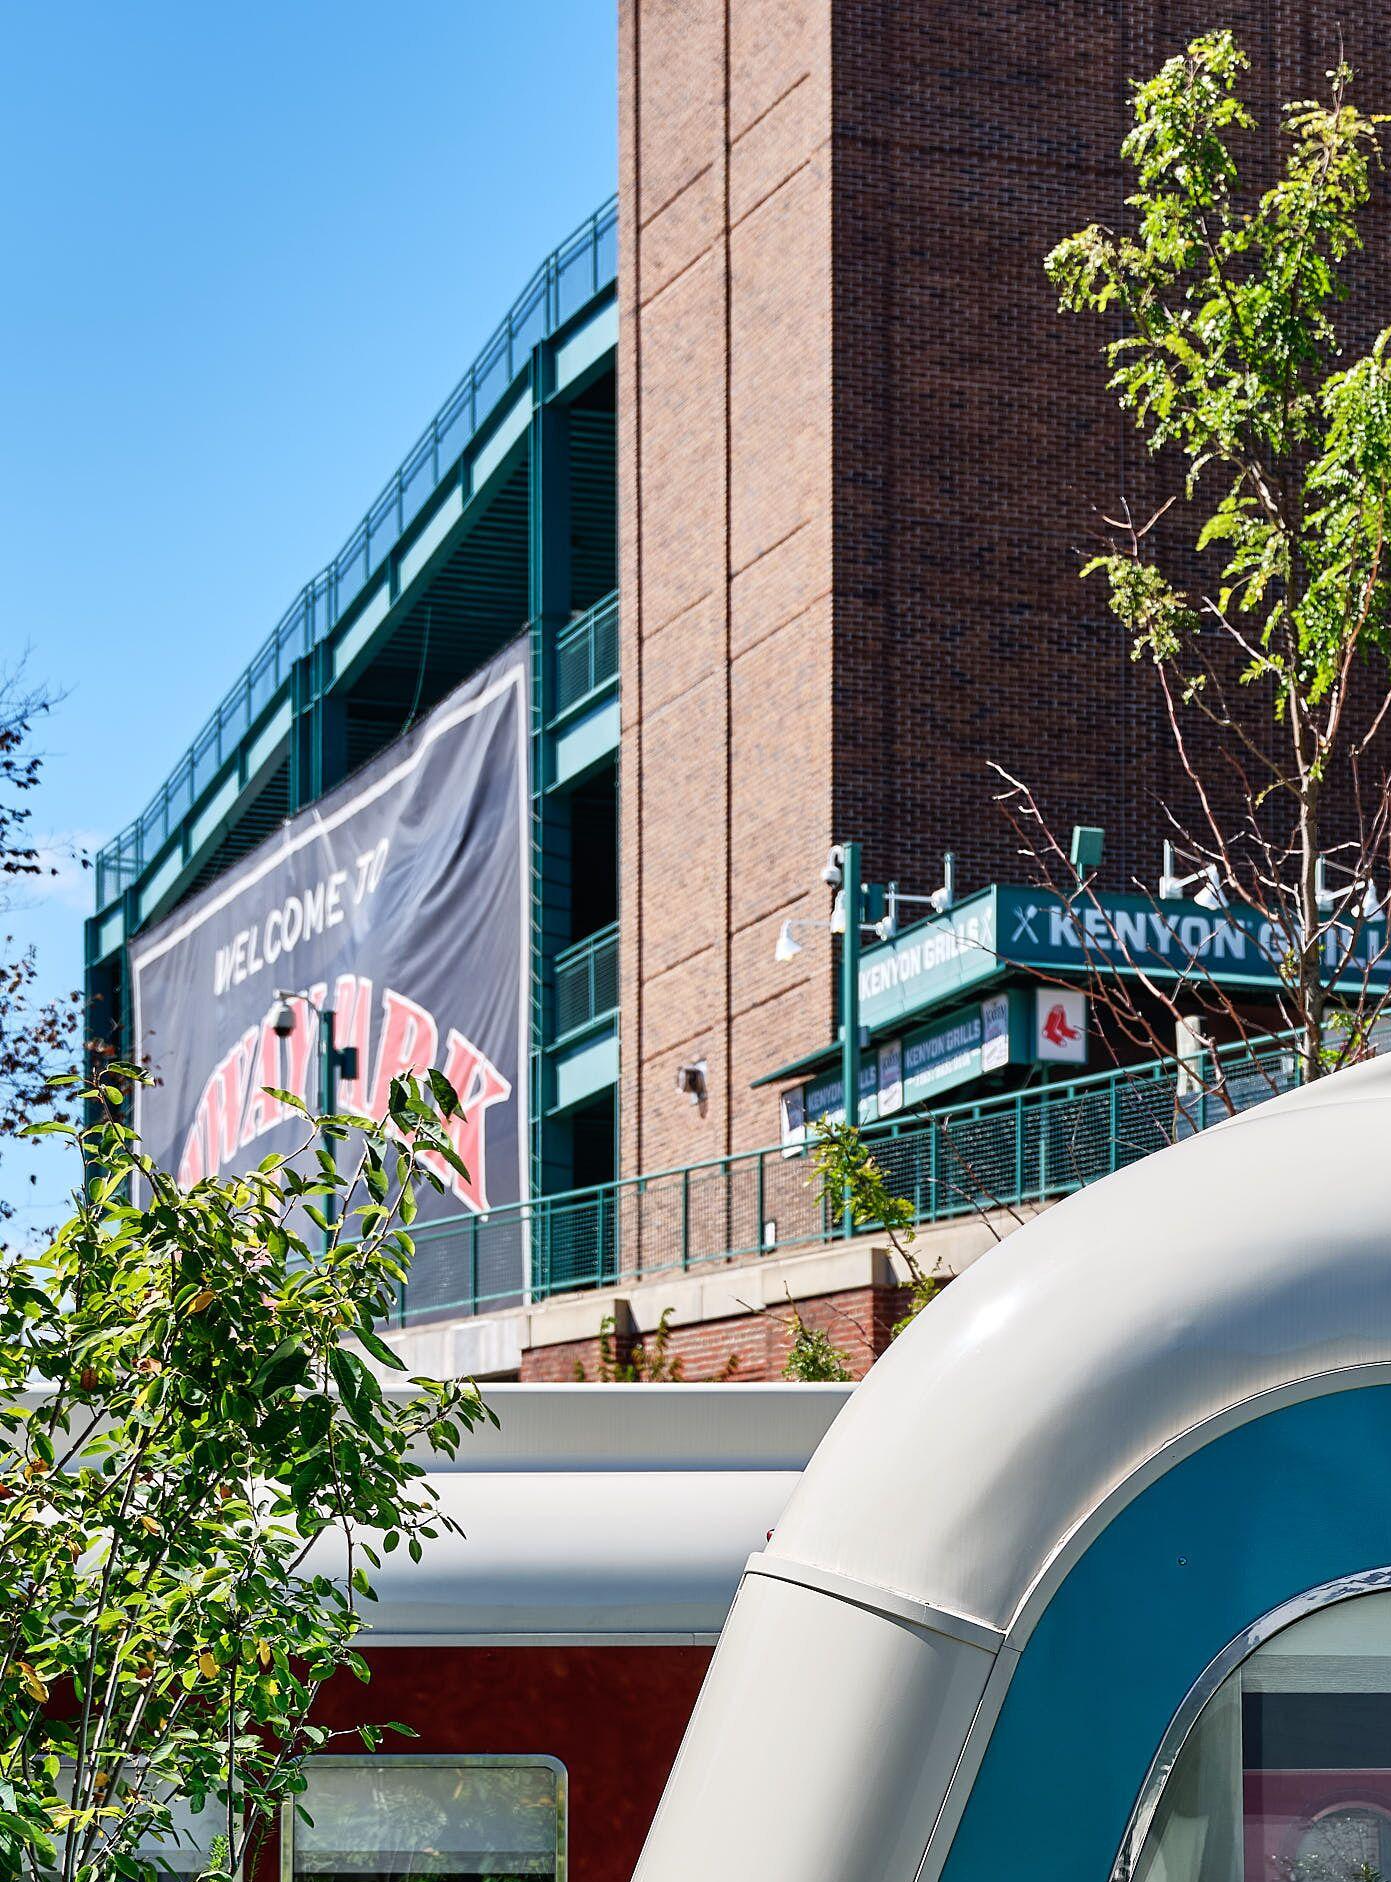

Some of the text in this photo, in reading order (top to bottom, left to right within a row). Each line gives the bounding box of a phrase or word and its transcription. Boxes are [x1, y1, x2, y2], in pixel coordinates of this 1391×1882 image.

[214, 870, 348, 996] WELCOME
[1050, 905, 1246, 960] KENYON
[858, 944, 922, 1002] KENYON
